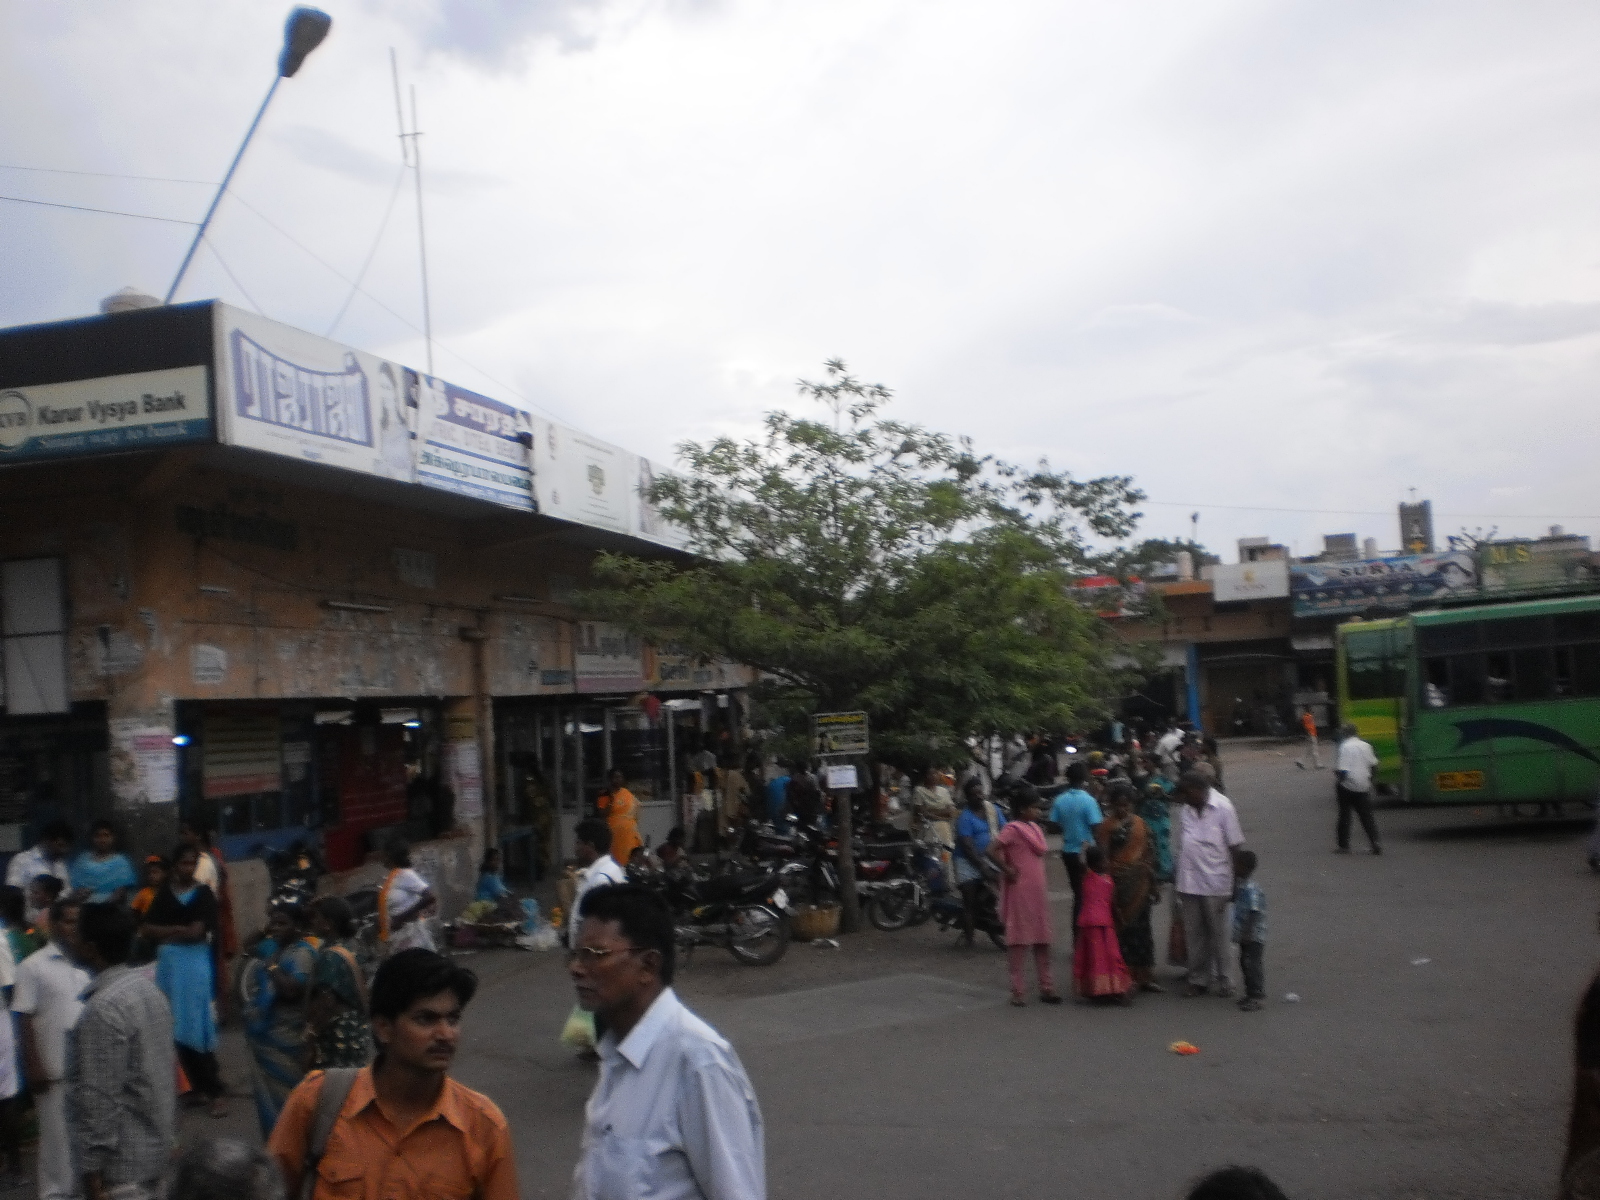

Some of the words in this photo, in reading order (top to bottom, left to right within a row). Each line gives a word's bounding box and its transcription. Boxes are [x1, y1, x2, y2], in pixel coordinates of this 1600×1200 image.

[37, 404, 83, 425] Karur
[87, 400, 138, 423] Vysya
[141, 390, 186, 414] Bank
